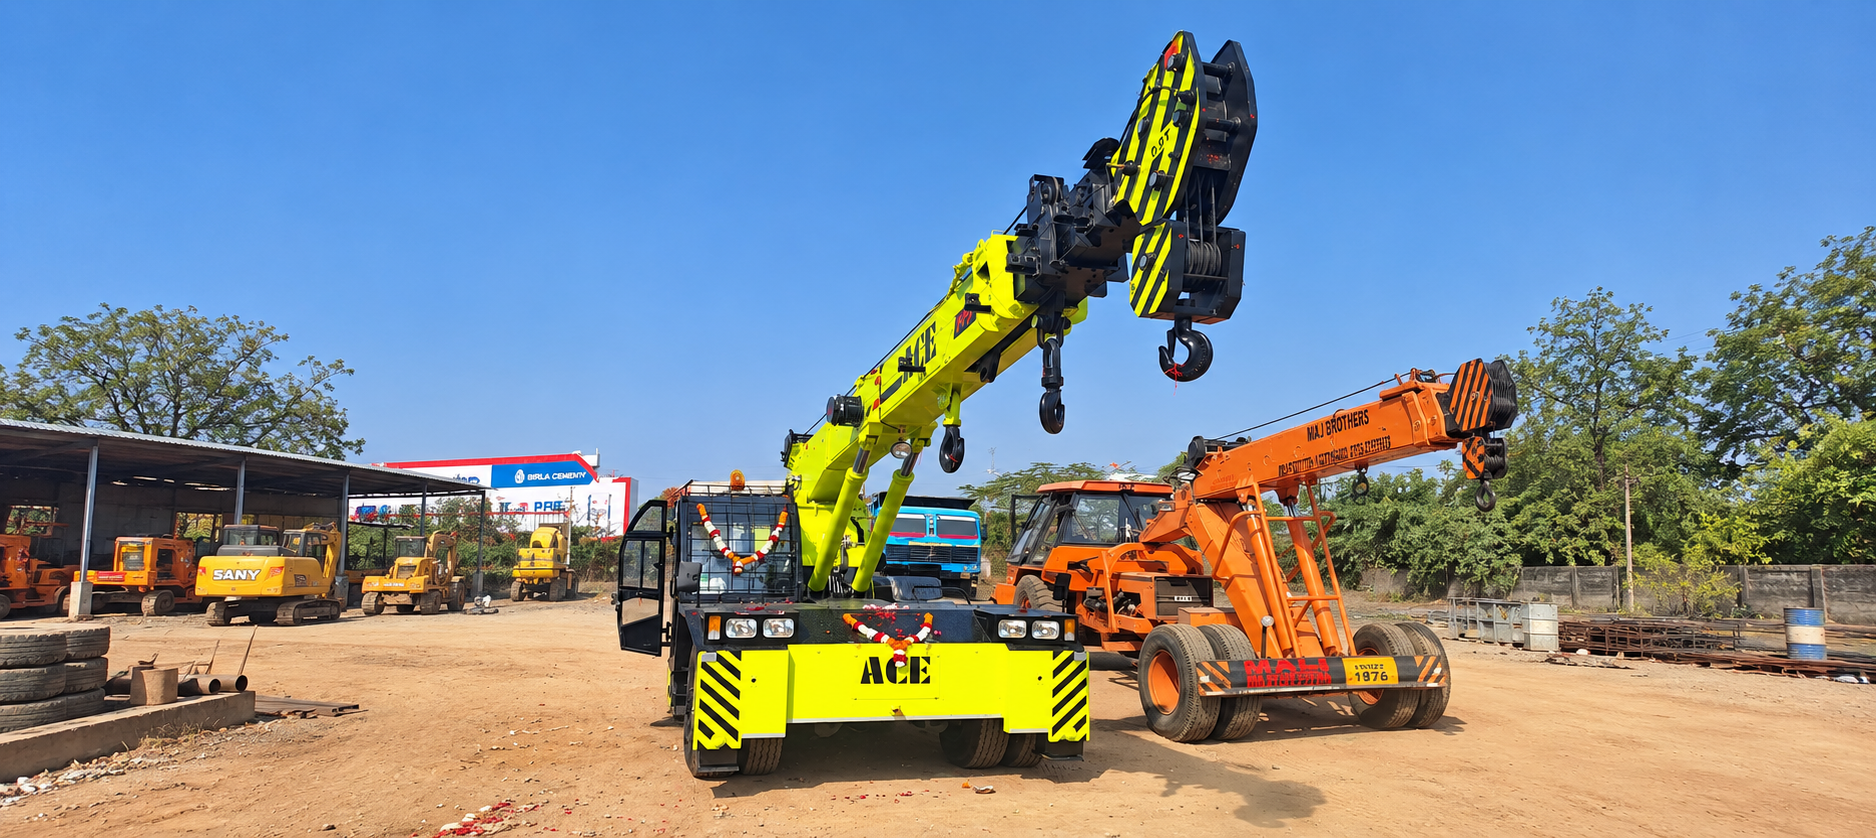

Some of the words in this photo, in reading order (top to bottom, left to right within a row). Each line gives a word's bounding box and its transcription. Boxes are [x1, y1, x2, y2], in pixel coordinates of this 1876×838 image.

[1307, 422, 1324, 442] MAJ
[1325, 409, 1370, 436] BROTHERS
[527, 473, 550, 481] BIRLA
[213, 569, 261, 581] SANY
[860, 656, 931, 684] ACE
[1355, 671, 1389, 682] 1976
